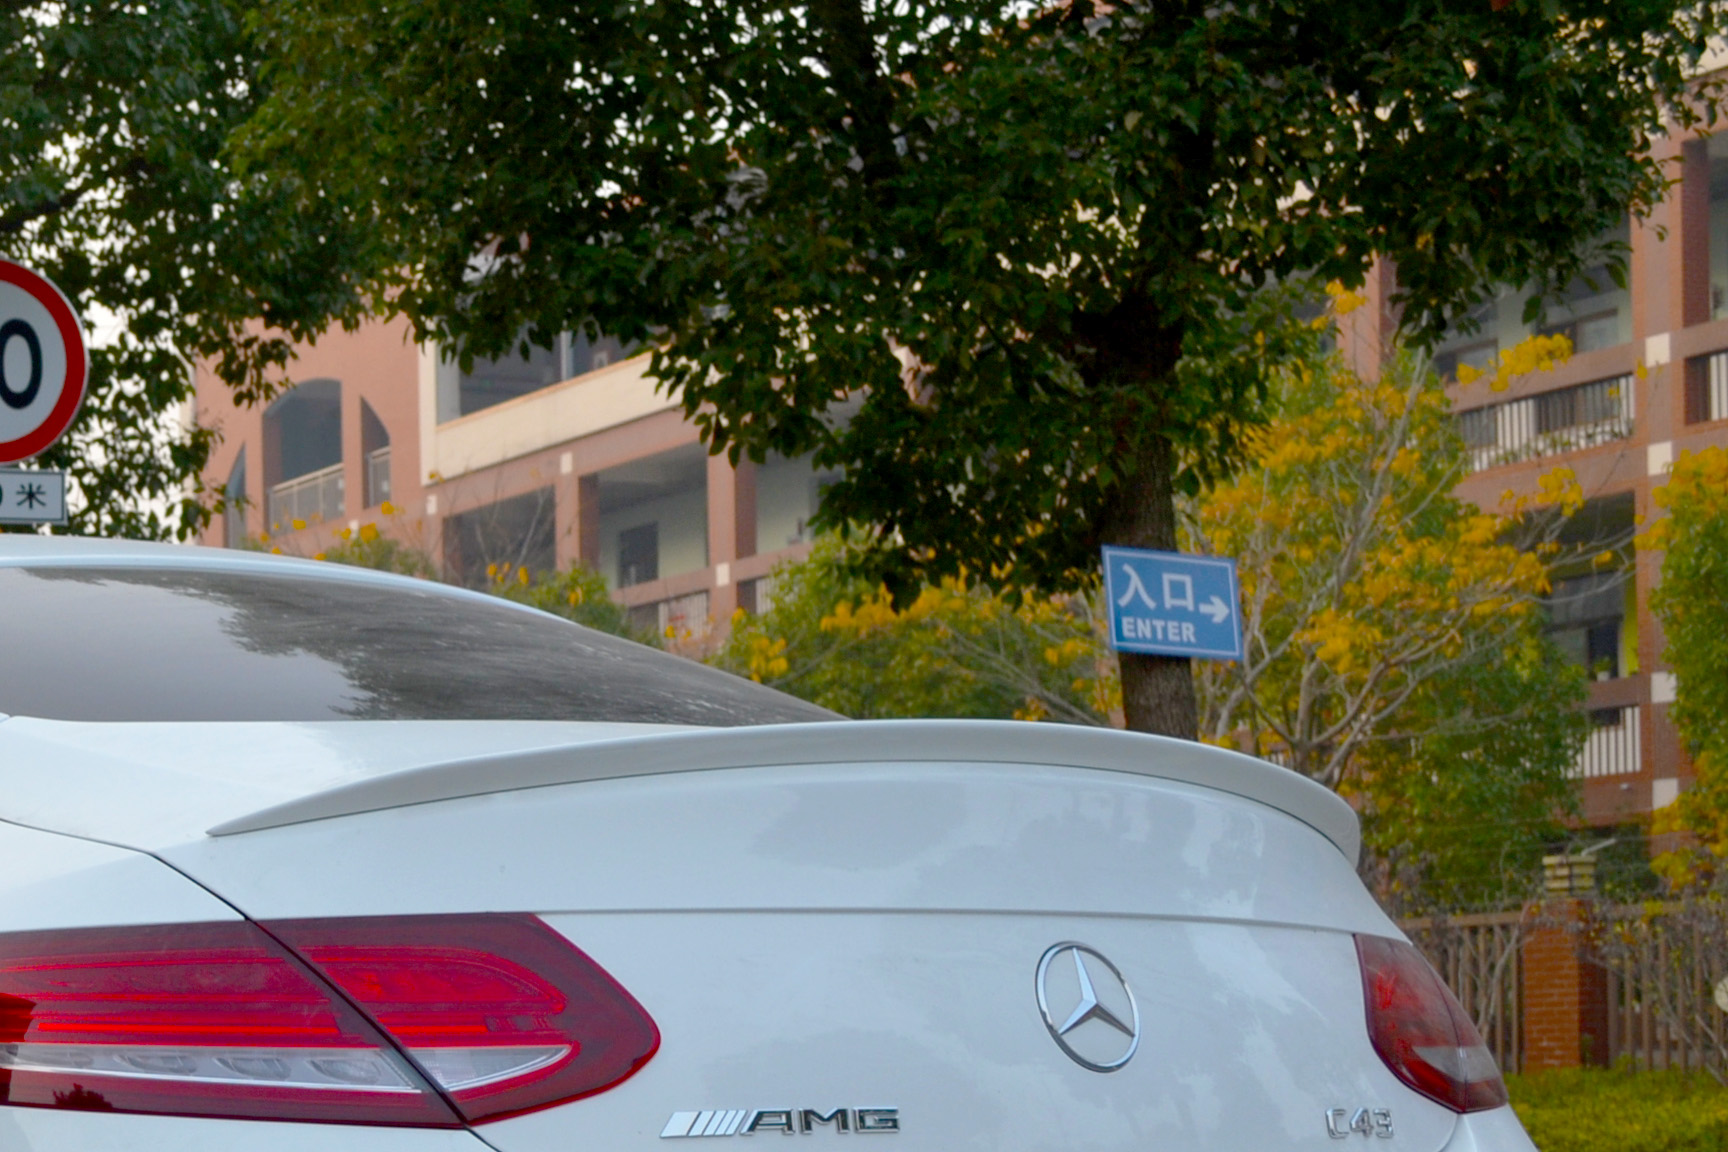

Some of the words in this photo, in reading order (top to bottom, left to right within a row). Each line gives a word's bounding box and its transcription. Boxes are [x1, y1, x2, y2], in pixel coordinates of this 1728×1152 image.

[1117, 563, 1195, 612] 入口
[1122, 616, 1197, 643] ENTER
[739, 1106, 900, 1136] AMG
[1325, 1107, 1394, 1139] C43
